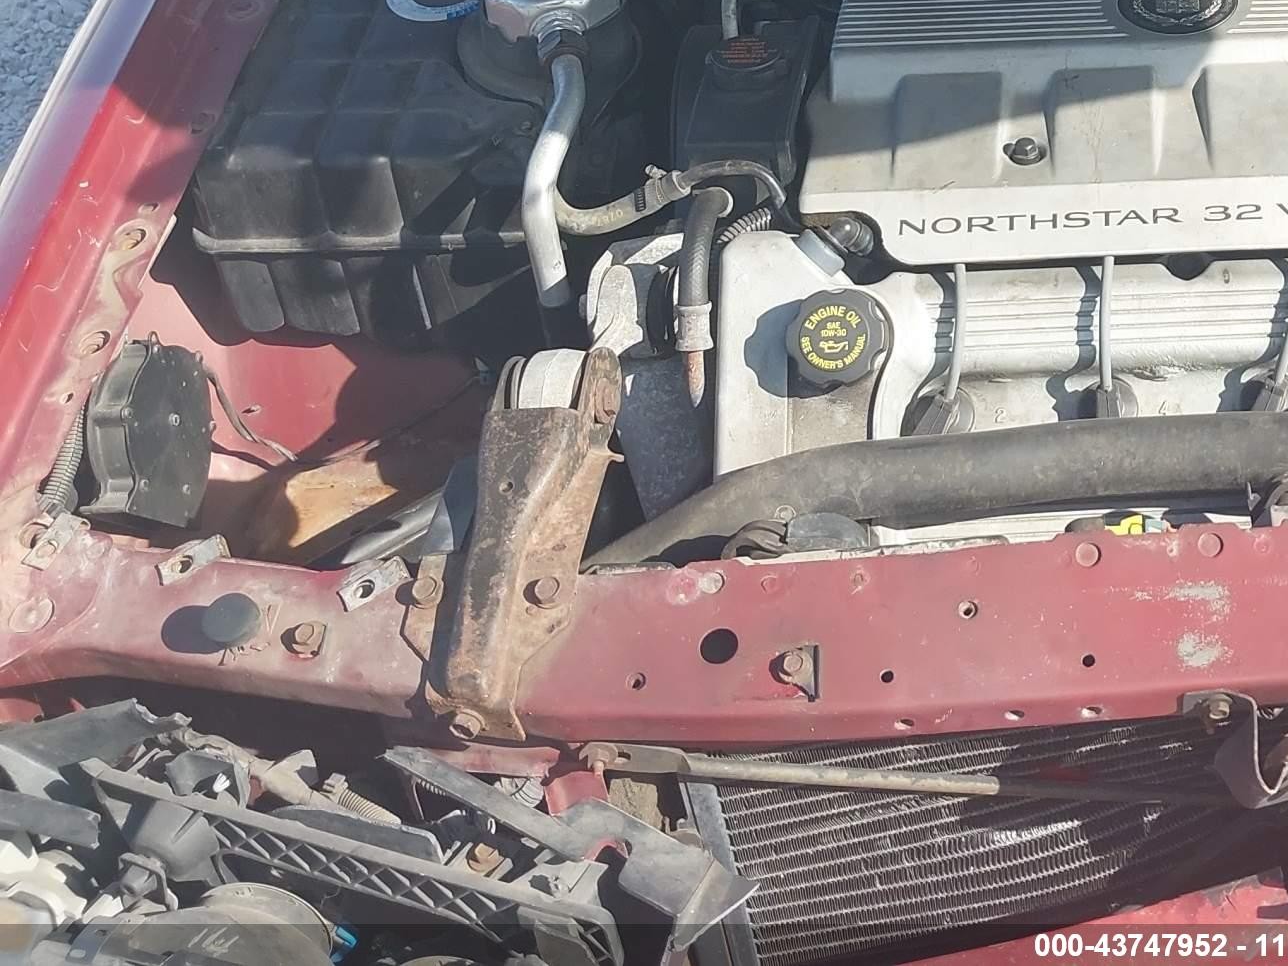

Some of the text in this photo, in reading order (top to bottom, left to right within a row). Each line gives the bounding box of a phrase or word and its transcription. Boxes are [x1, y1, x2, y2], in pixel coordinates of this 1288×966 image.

[899, 207, 1184, 235] NORTHSTAR
[1203, 204, 1263, 222] 32
[804, 305, 862, 330] ENGINE OIL
[826, 321, 841, 330] SAE
[821, 329, 847, 338] 10W-30
[801, 333, 866, 369] SEE OWNER'S MANUAL
[993, 405, 1007, 425] 2
[1157, 399, 1169, 416] 4
